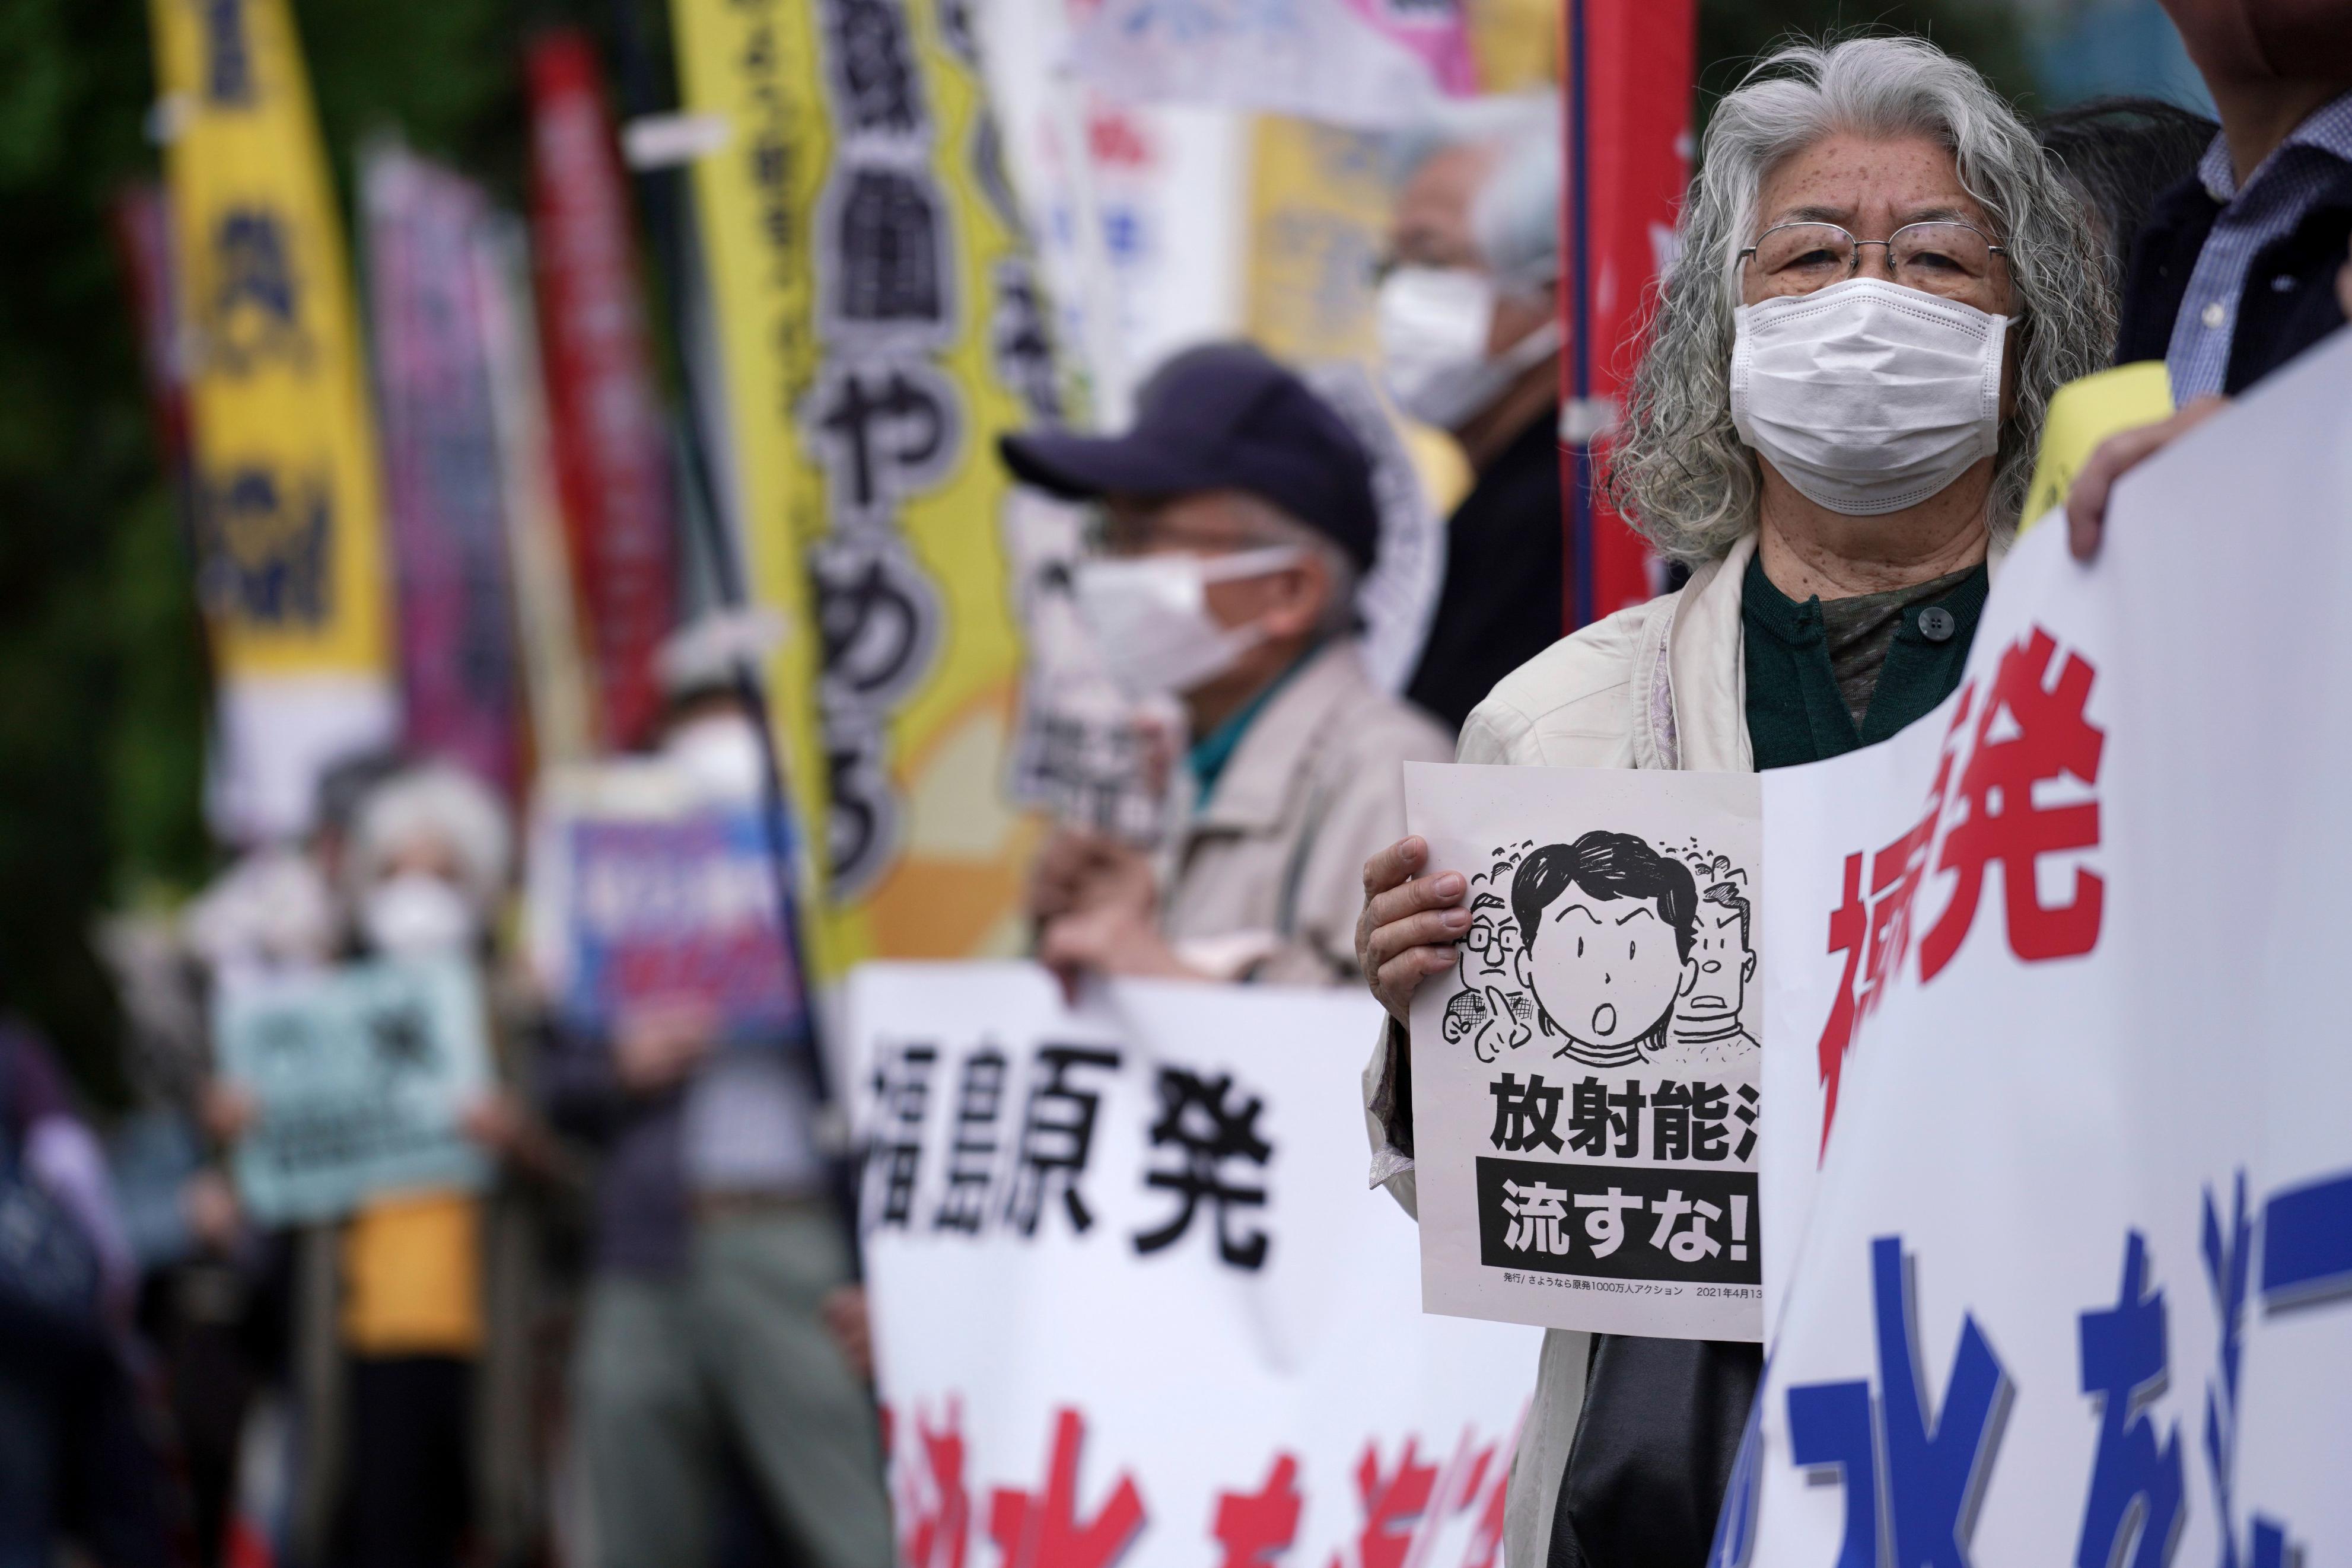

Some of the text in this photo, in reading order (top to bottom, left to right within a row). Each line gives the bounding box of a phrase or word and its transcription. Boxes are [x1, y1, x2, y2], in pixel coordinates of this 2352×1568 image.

[1528, 1274, 1683, 1296] さようなら原発1000万人アクション
